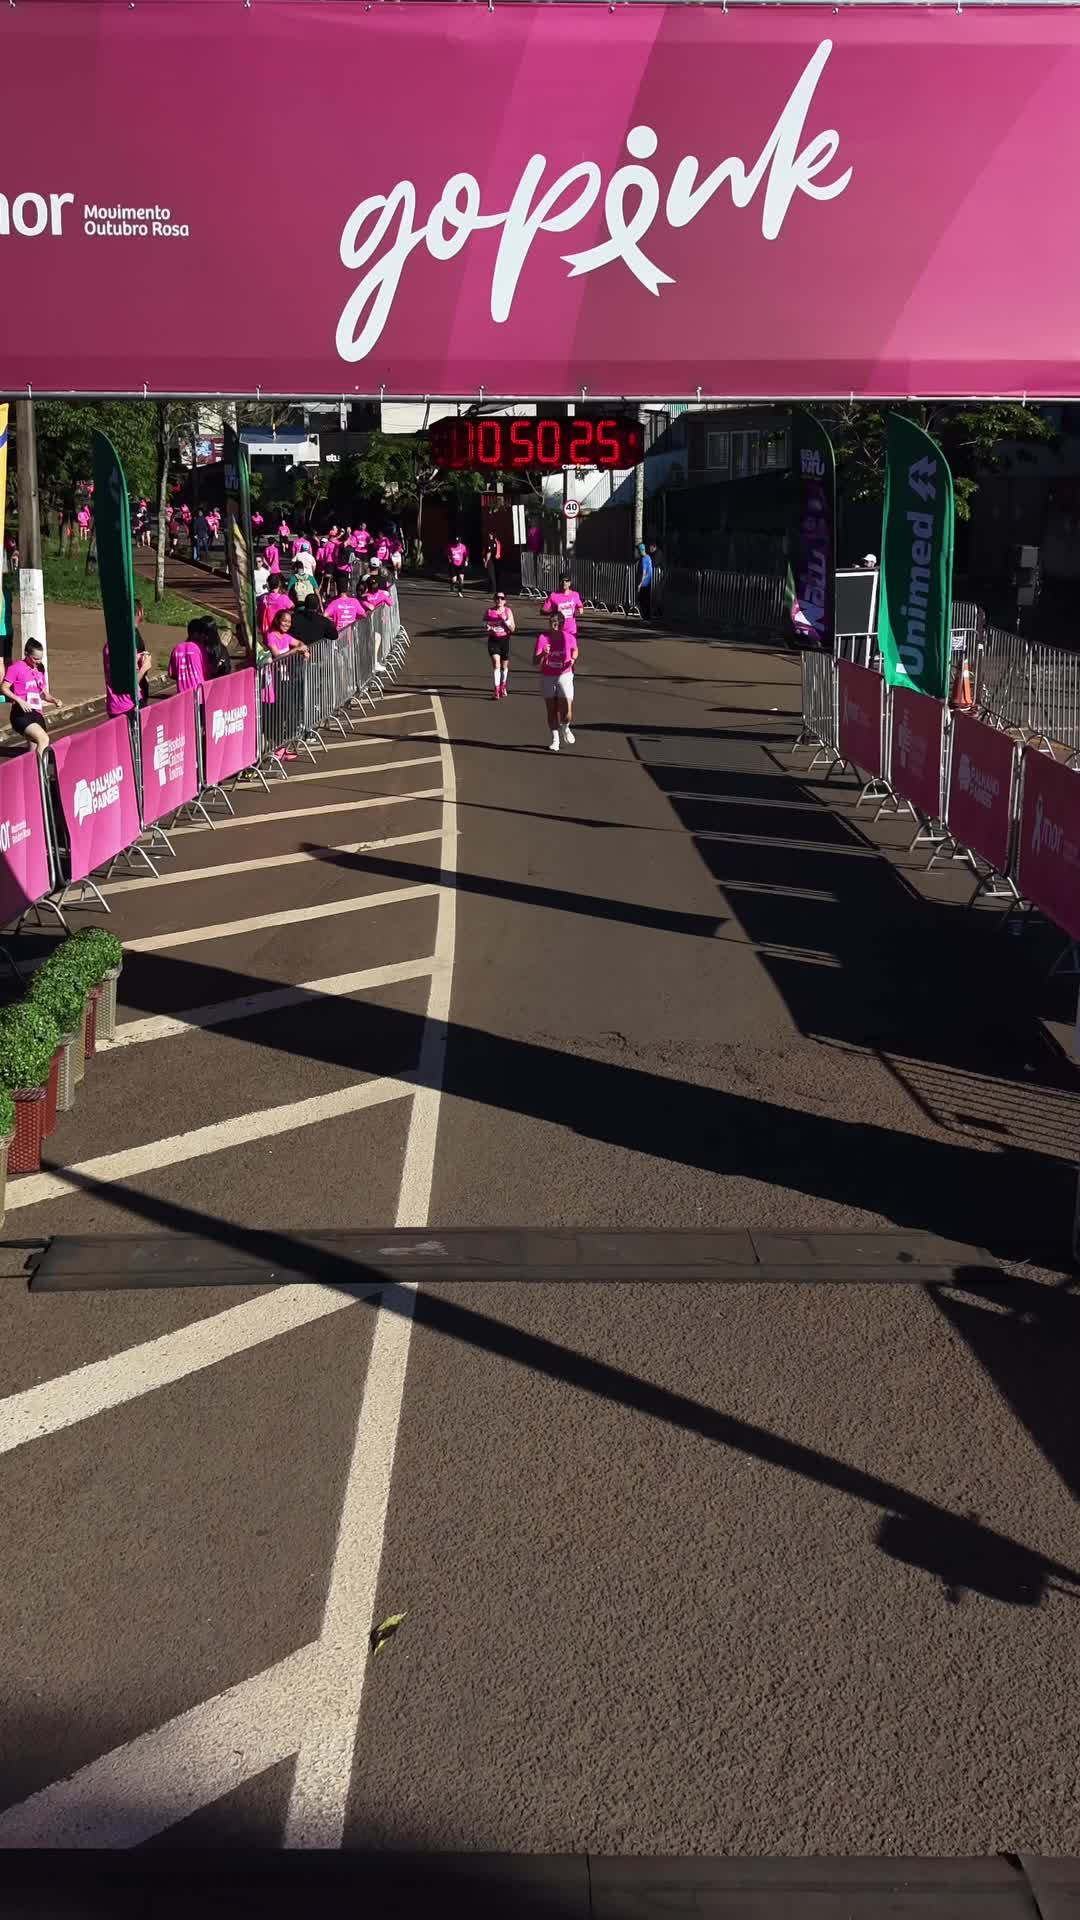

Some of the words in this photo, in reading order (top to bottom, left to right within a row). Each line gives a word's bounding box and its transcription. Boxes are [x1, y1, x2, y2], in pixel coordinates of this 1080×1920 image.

[84, 204, 171, 220] Movimento
[336, 39, 853, 362] gopink
[84, 220, 148, 236] Outubro
[152, 222, 189, 236] Rosa
[565, 503, 577, 511] 40
[898, 511, 934, 676] Unimed
[90, 765, 123, 798] PALHANO
